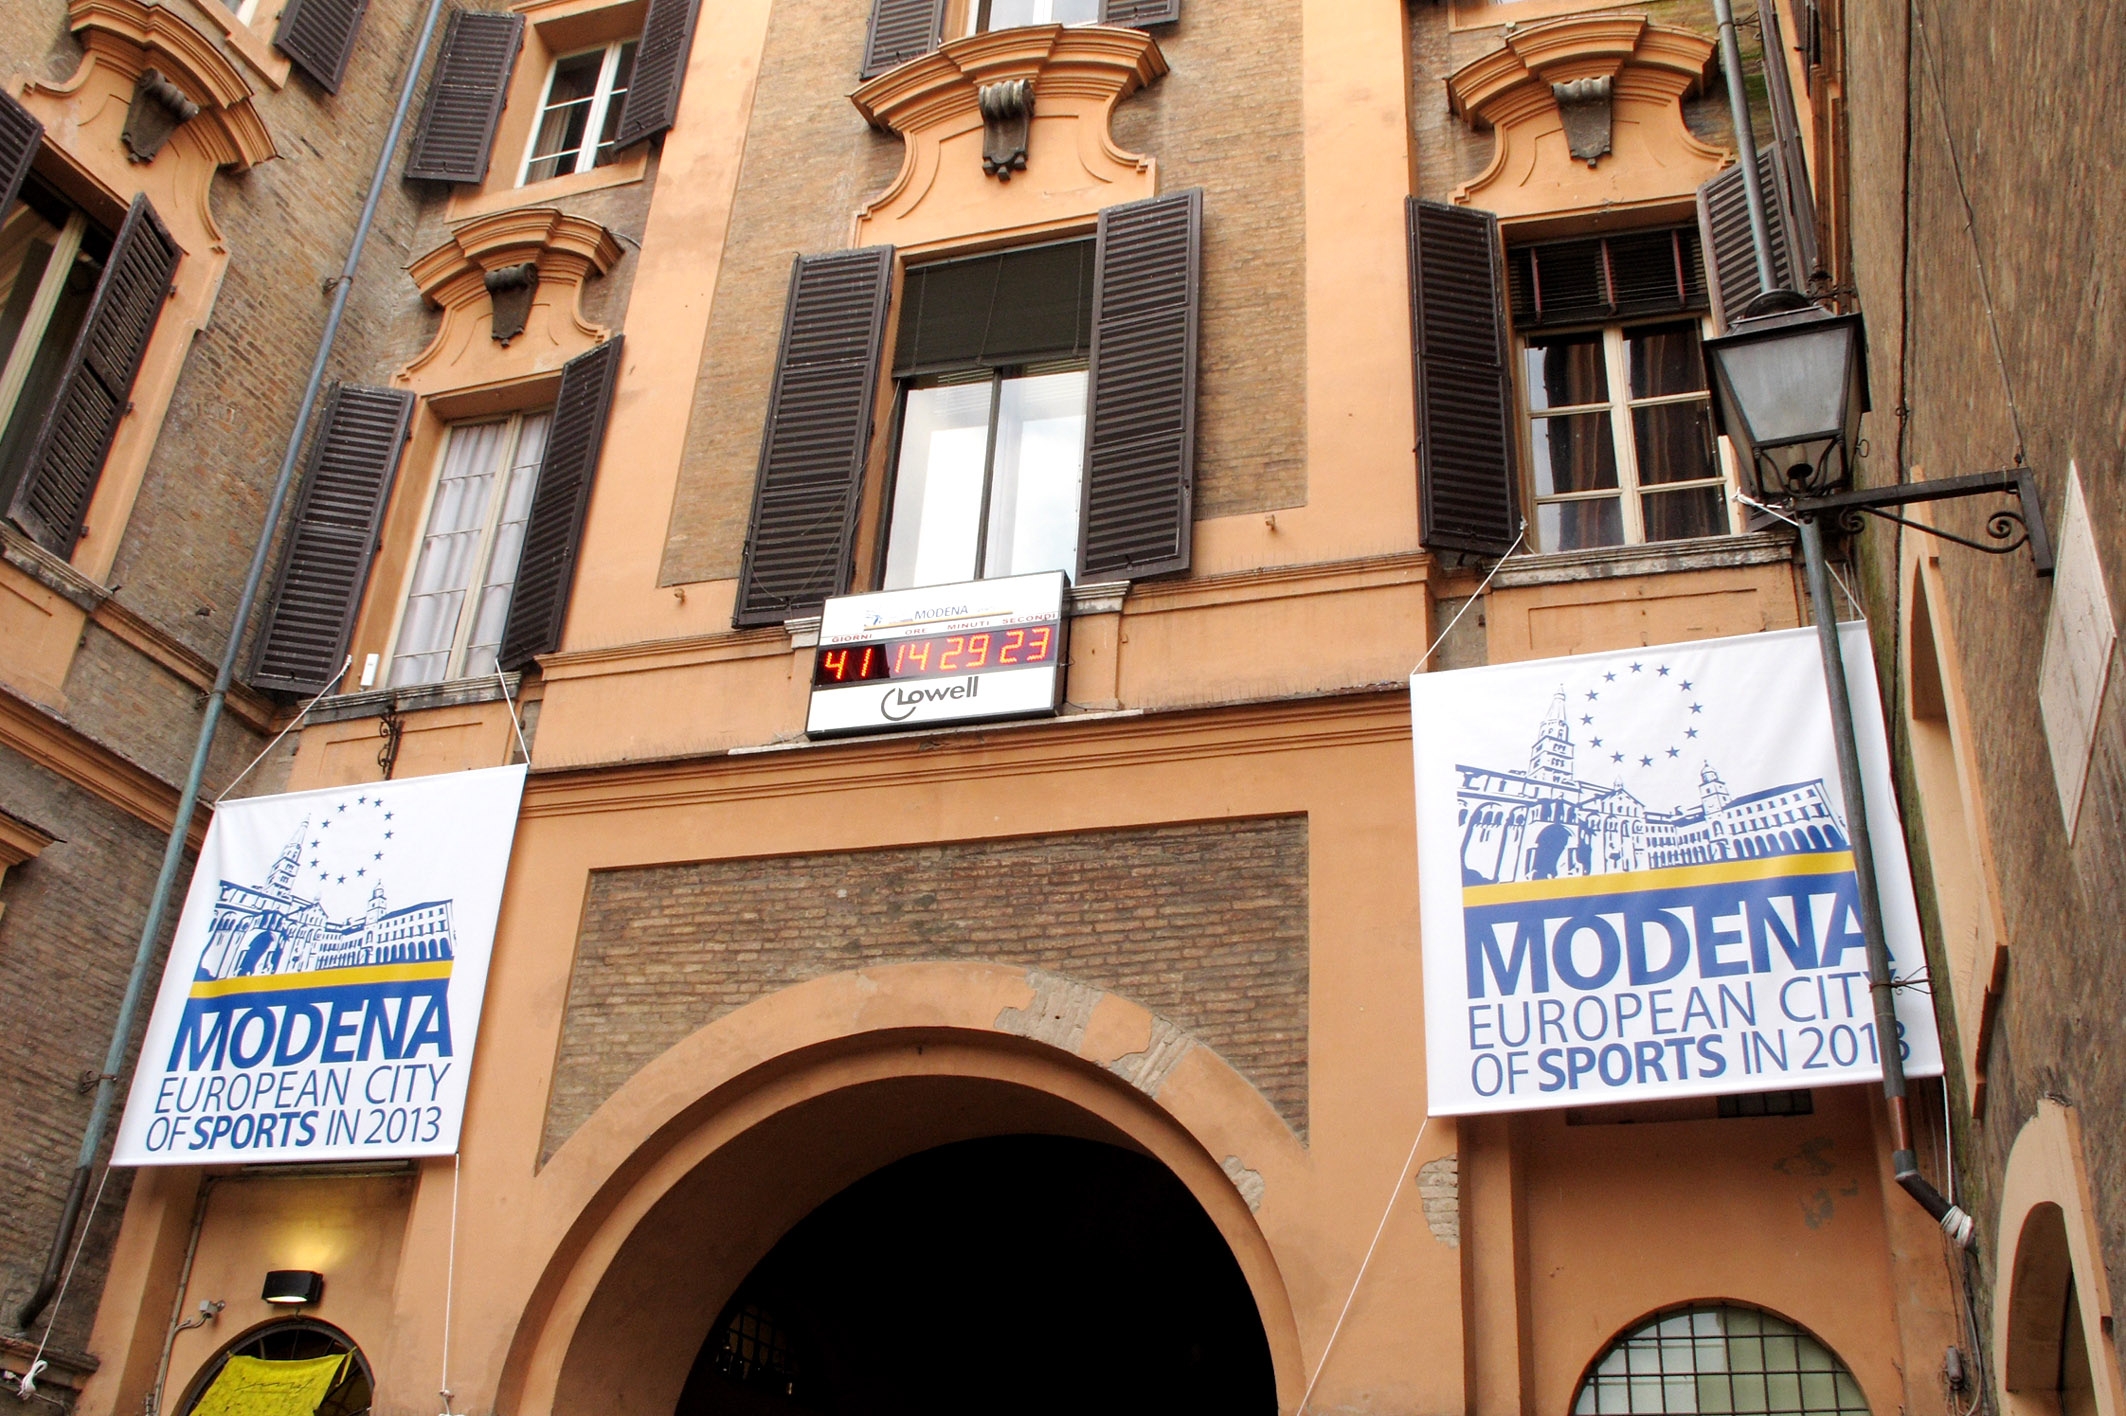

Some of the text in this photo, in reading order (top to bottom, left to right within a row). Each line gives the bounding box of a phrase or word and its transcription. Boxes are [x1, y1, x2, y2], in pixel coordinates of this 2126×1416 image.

[831, 613, 1056, 643] GIORNI ORE MINUTI SECONDI
[914, 605, 968, 619] MODENA
[896, 676, 979, 706] Lowell
[1464, 889, 1895, 999] MODENA
[166, 995, 453, 1073] MODENA
[1468, 982, 1755, 1050] EUROPEAN
[154, 1062, 452, 1114] EUROPEAN CITY
[1471, 1054, 1528, 1097] OF
[1537, 1033, 1727, 1092] SPORTS
[1741, 1028, 1788, 1075] IN
[146, 1105, 442, 1152] OF SPORTS IN 2013
